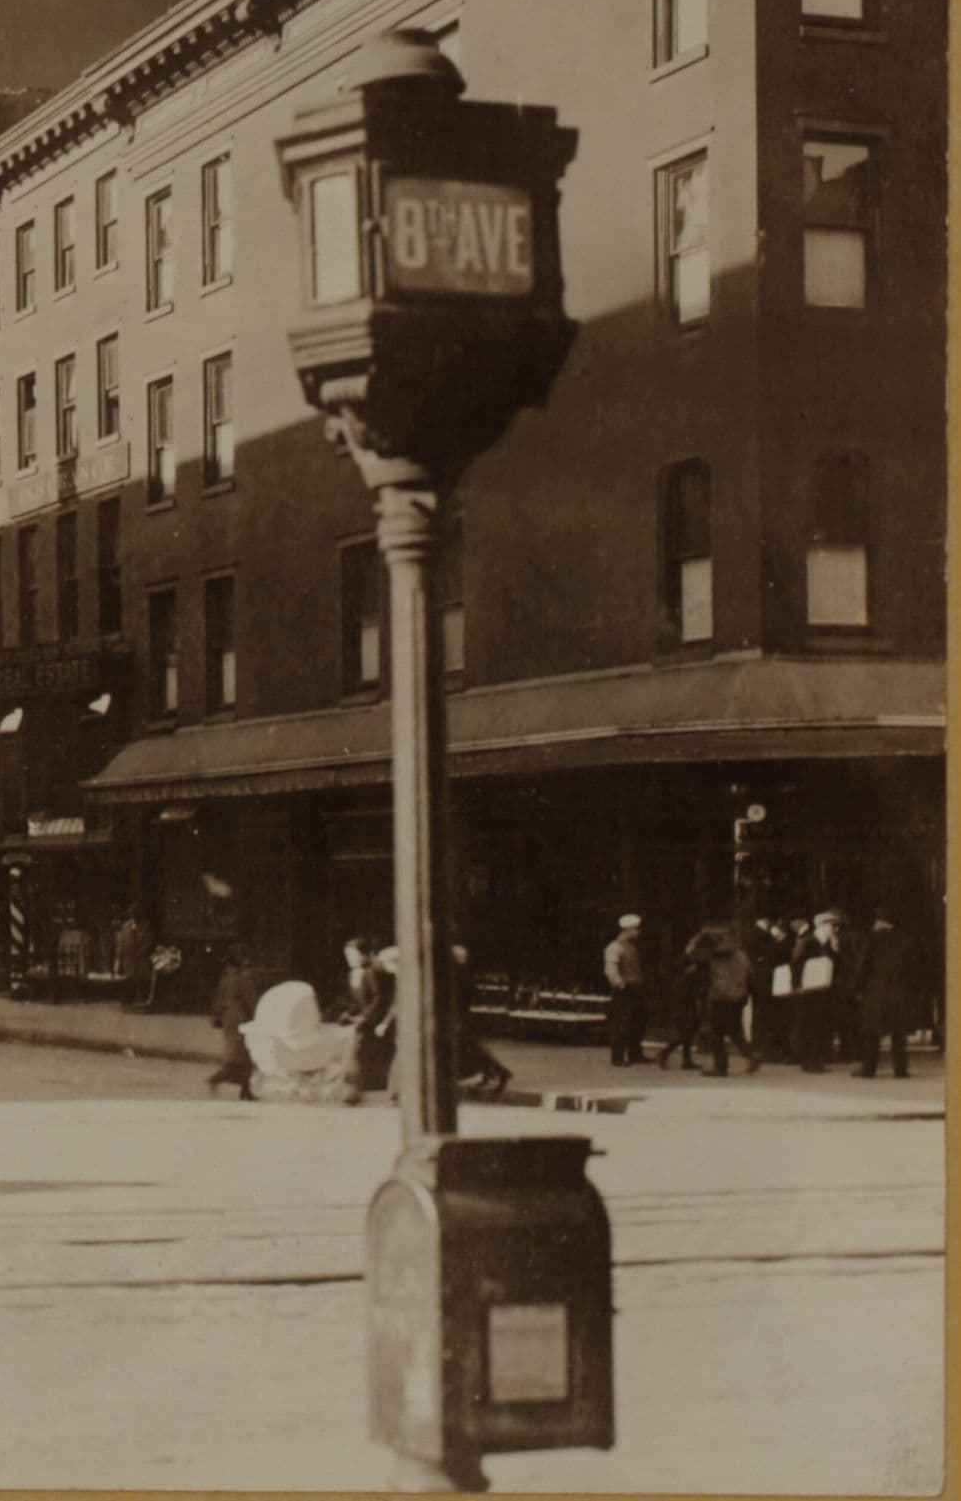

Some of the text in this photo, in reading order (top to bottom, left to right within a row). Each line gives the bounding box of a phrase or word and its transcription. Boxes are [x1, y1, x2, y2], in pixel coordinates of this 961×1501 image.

[455, 202, 530, 275] AVE
[20, 453, 116, 500] INSUNCE
[35, 658, 91, 687] ESTATE
